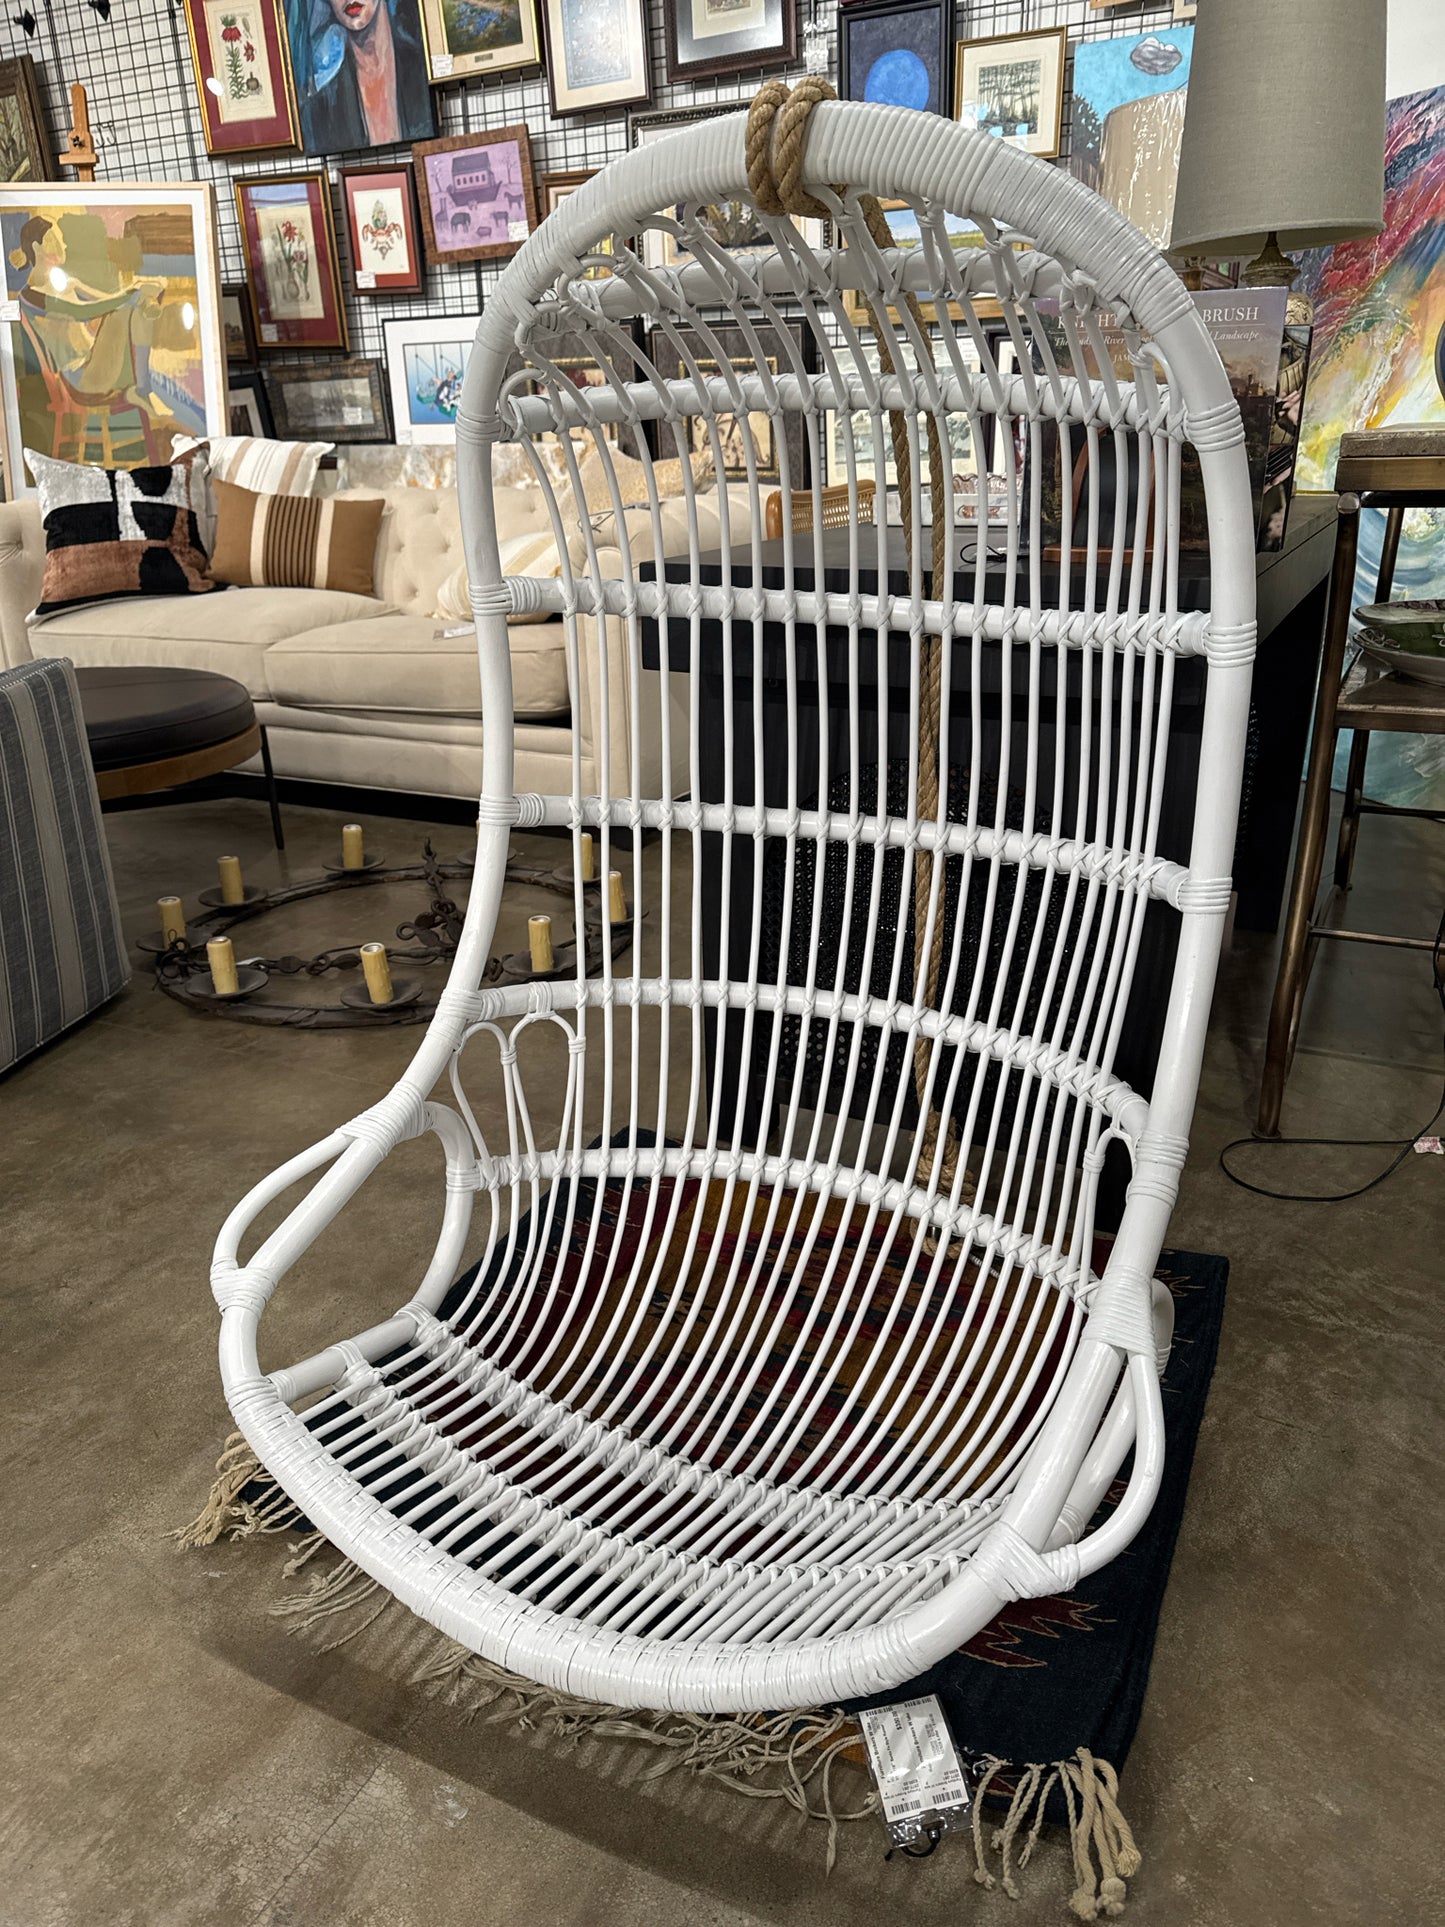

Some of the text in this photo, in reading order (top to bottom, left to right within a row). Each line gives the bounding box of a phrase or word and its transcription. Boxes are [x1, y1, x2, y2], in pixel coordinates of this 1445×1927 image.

[1202, 306, 1259, 322] BRUSH
[1103, 335, 1125, 345] River
[1213, 329, 1259, 342] Landscape
